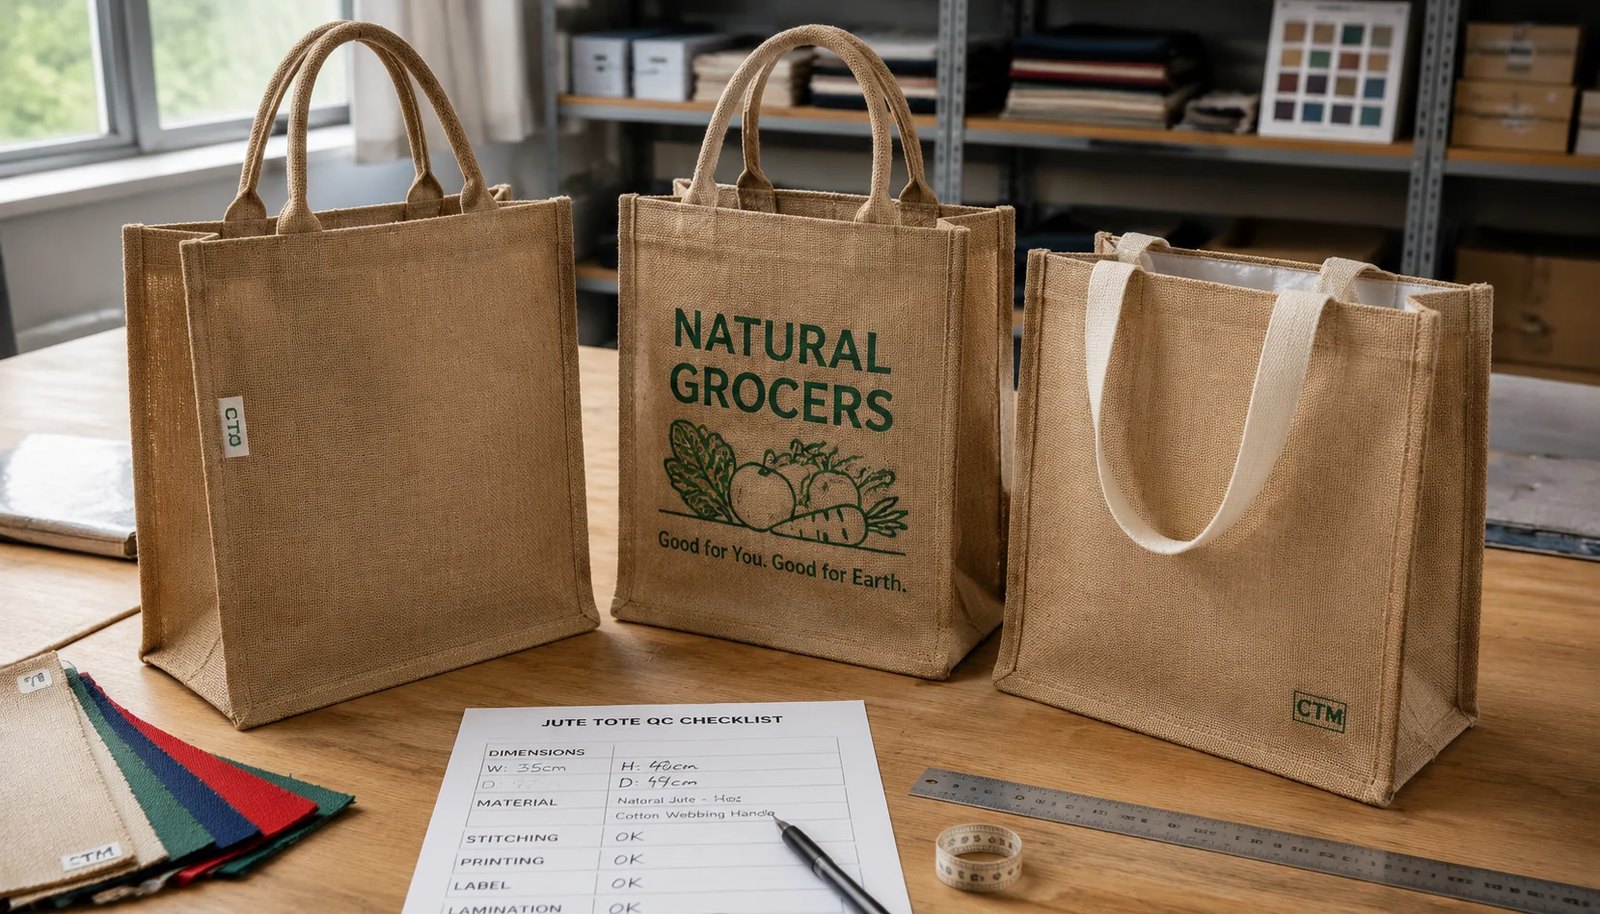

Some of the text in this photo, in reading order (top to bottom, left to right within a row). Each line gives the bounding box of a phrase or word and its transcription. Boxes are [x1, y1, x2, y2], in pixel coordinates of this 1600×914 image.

[674, 307, 892, 375] NATURAL
[670, 362, 893, 433] GROCERS
[658, 531, 908, 593] Good for You. Good for Earth.
[1297, 699, 1343, 726] CTM
[542, 715, 784, 728] JUTE TOTE QC CHECKLIST
[488, 748, 585, 757] DIMENSIONS
[487, 762, 566, 773] W: 35cm
[621, 761, 641, 771] H:
[618, 777, 639, 788] D:
[476, 798, 558, 808] MATERIAL
[615, 811, 660, 820] Cotton
[466, 833, 559, 843] STITCHING
[615, 831, 644, 842] OK
[460, 856, 545, 866] PRINTING
[614, 853, 645, 865] OK
[454, 881, 511, 891] LABEL
[611, 876, 643, 889] OK
[448, 904, 562, 914] LAMINATION
[608, 901, 641, 914] OK
